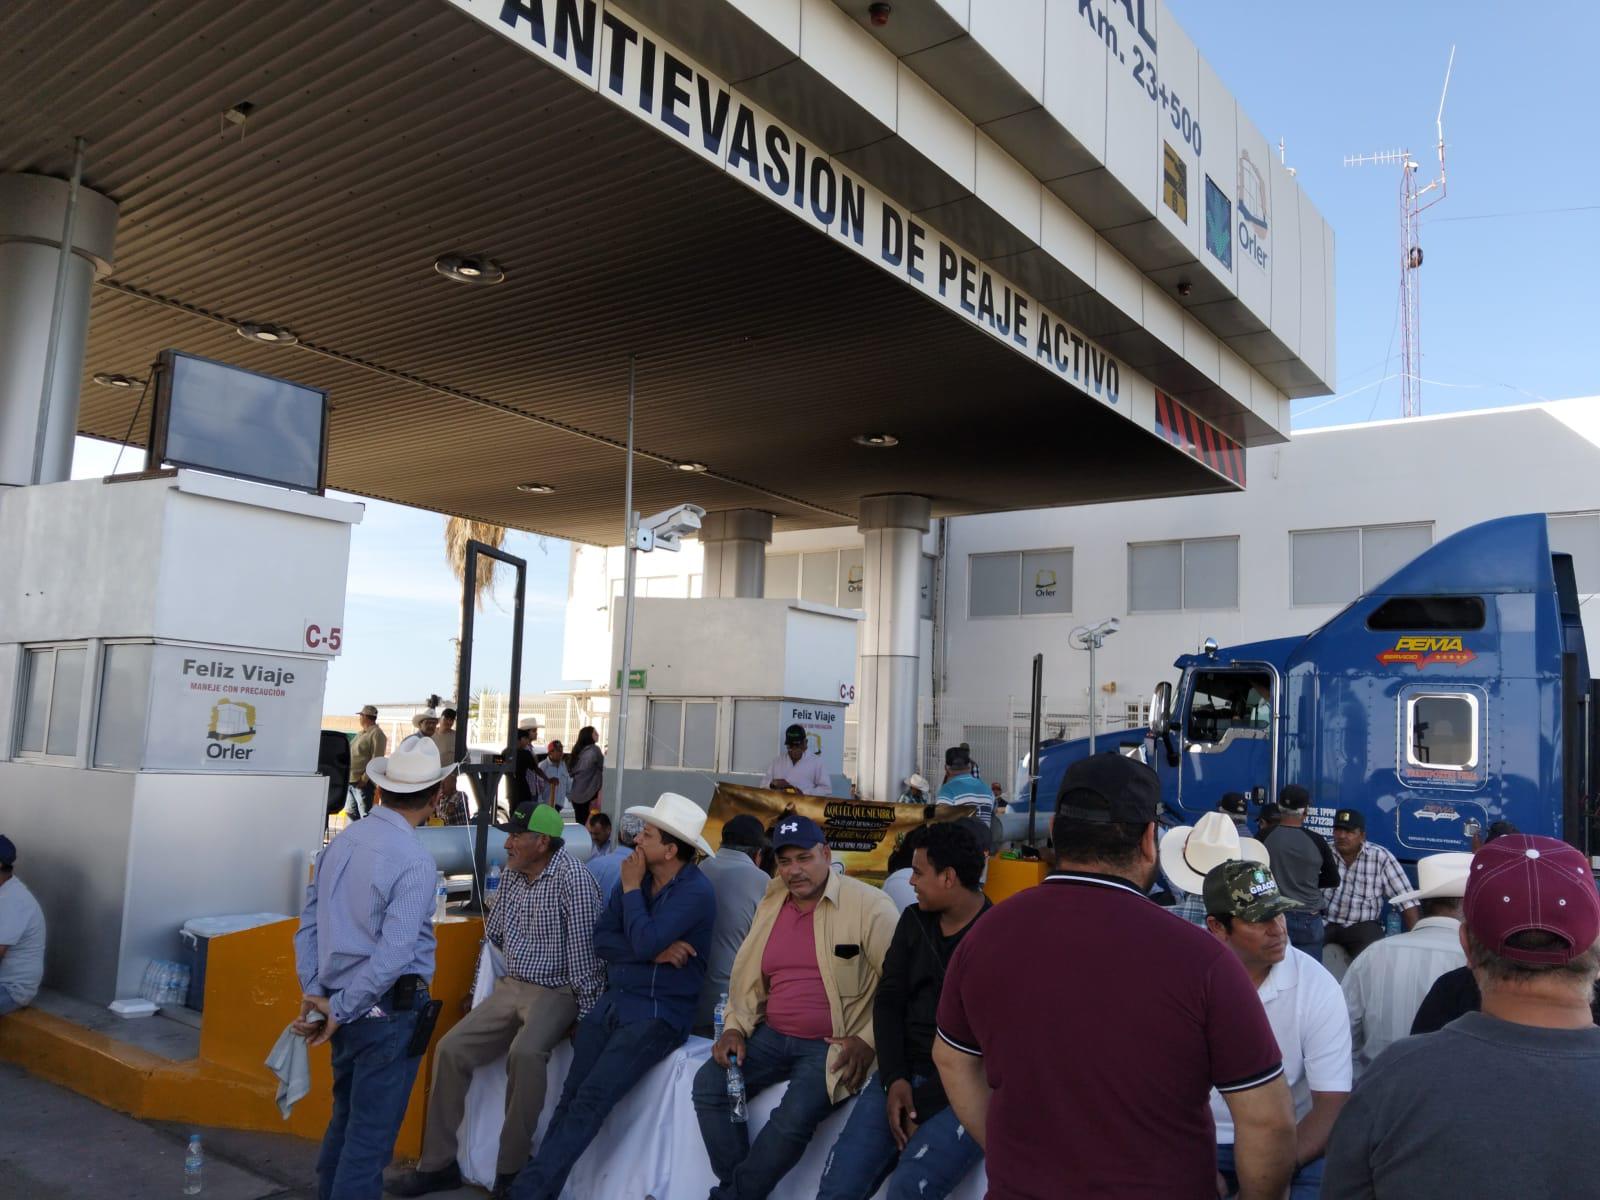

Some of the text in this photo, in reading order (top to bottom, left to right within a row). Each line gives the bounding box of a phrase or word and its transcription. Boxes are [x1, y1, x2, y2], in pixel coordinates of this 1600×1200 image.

[1132, 44, 1202, 157] 23+500
[1239, 221, 1268, 270] Orler
[882, 201, 925, 284] DE
[939, 241, 1028, 348] PEAJE
[1036, 311, 1120, 405] ACTIVO
[305, 624, 342, 650] C-5
[1395, 637, 1463, 651] PEMA
[182, 658, 295, 687] Feliz Viaje
[190, 682, 221, 692] MANEJE
[223, 685, 239, 694] CON
[840, 684, 855, 700] C-6
[792, 708, 836, 724] Feliz Viaje
[206, 743, 253, 760] Orler
